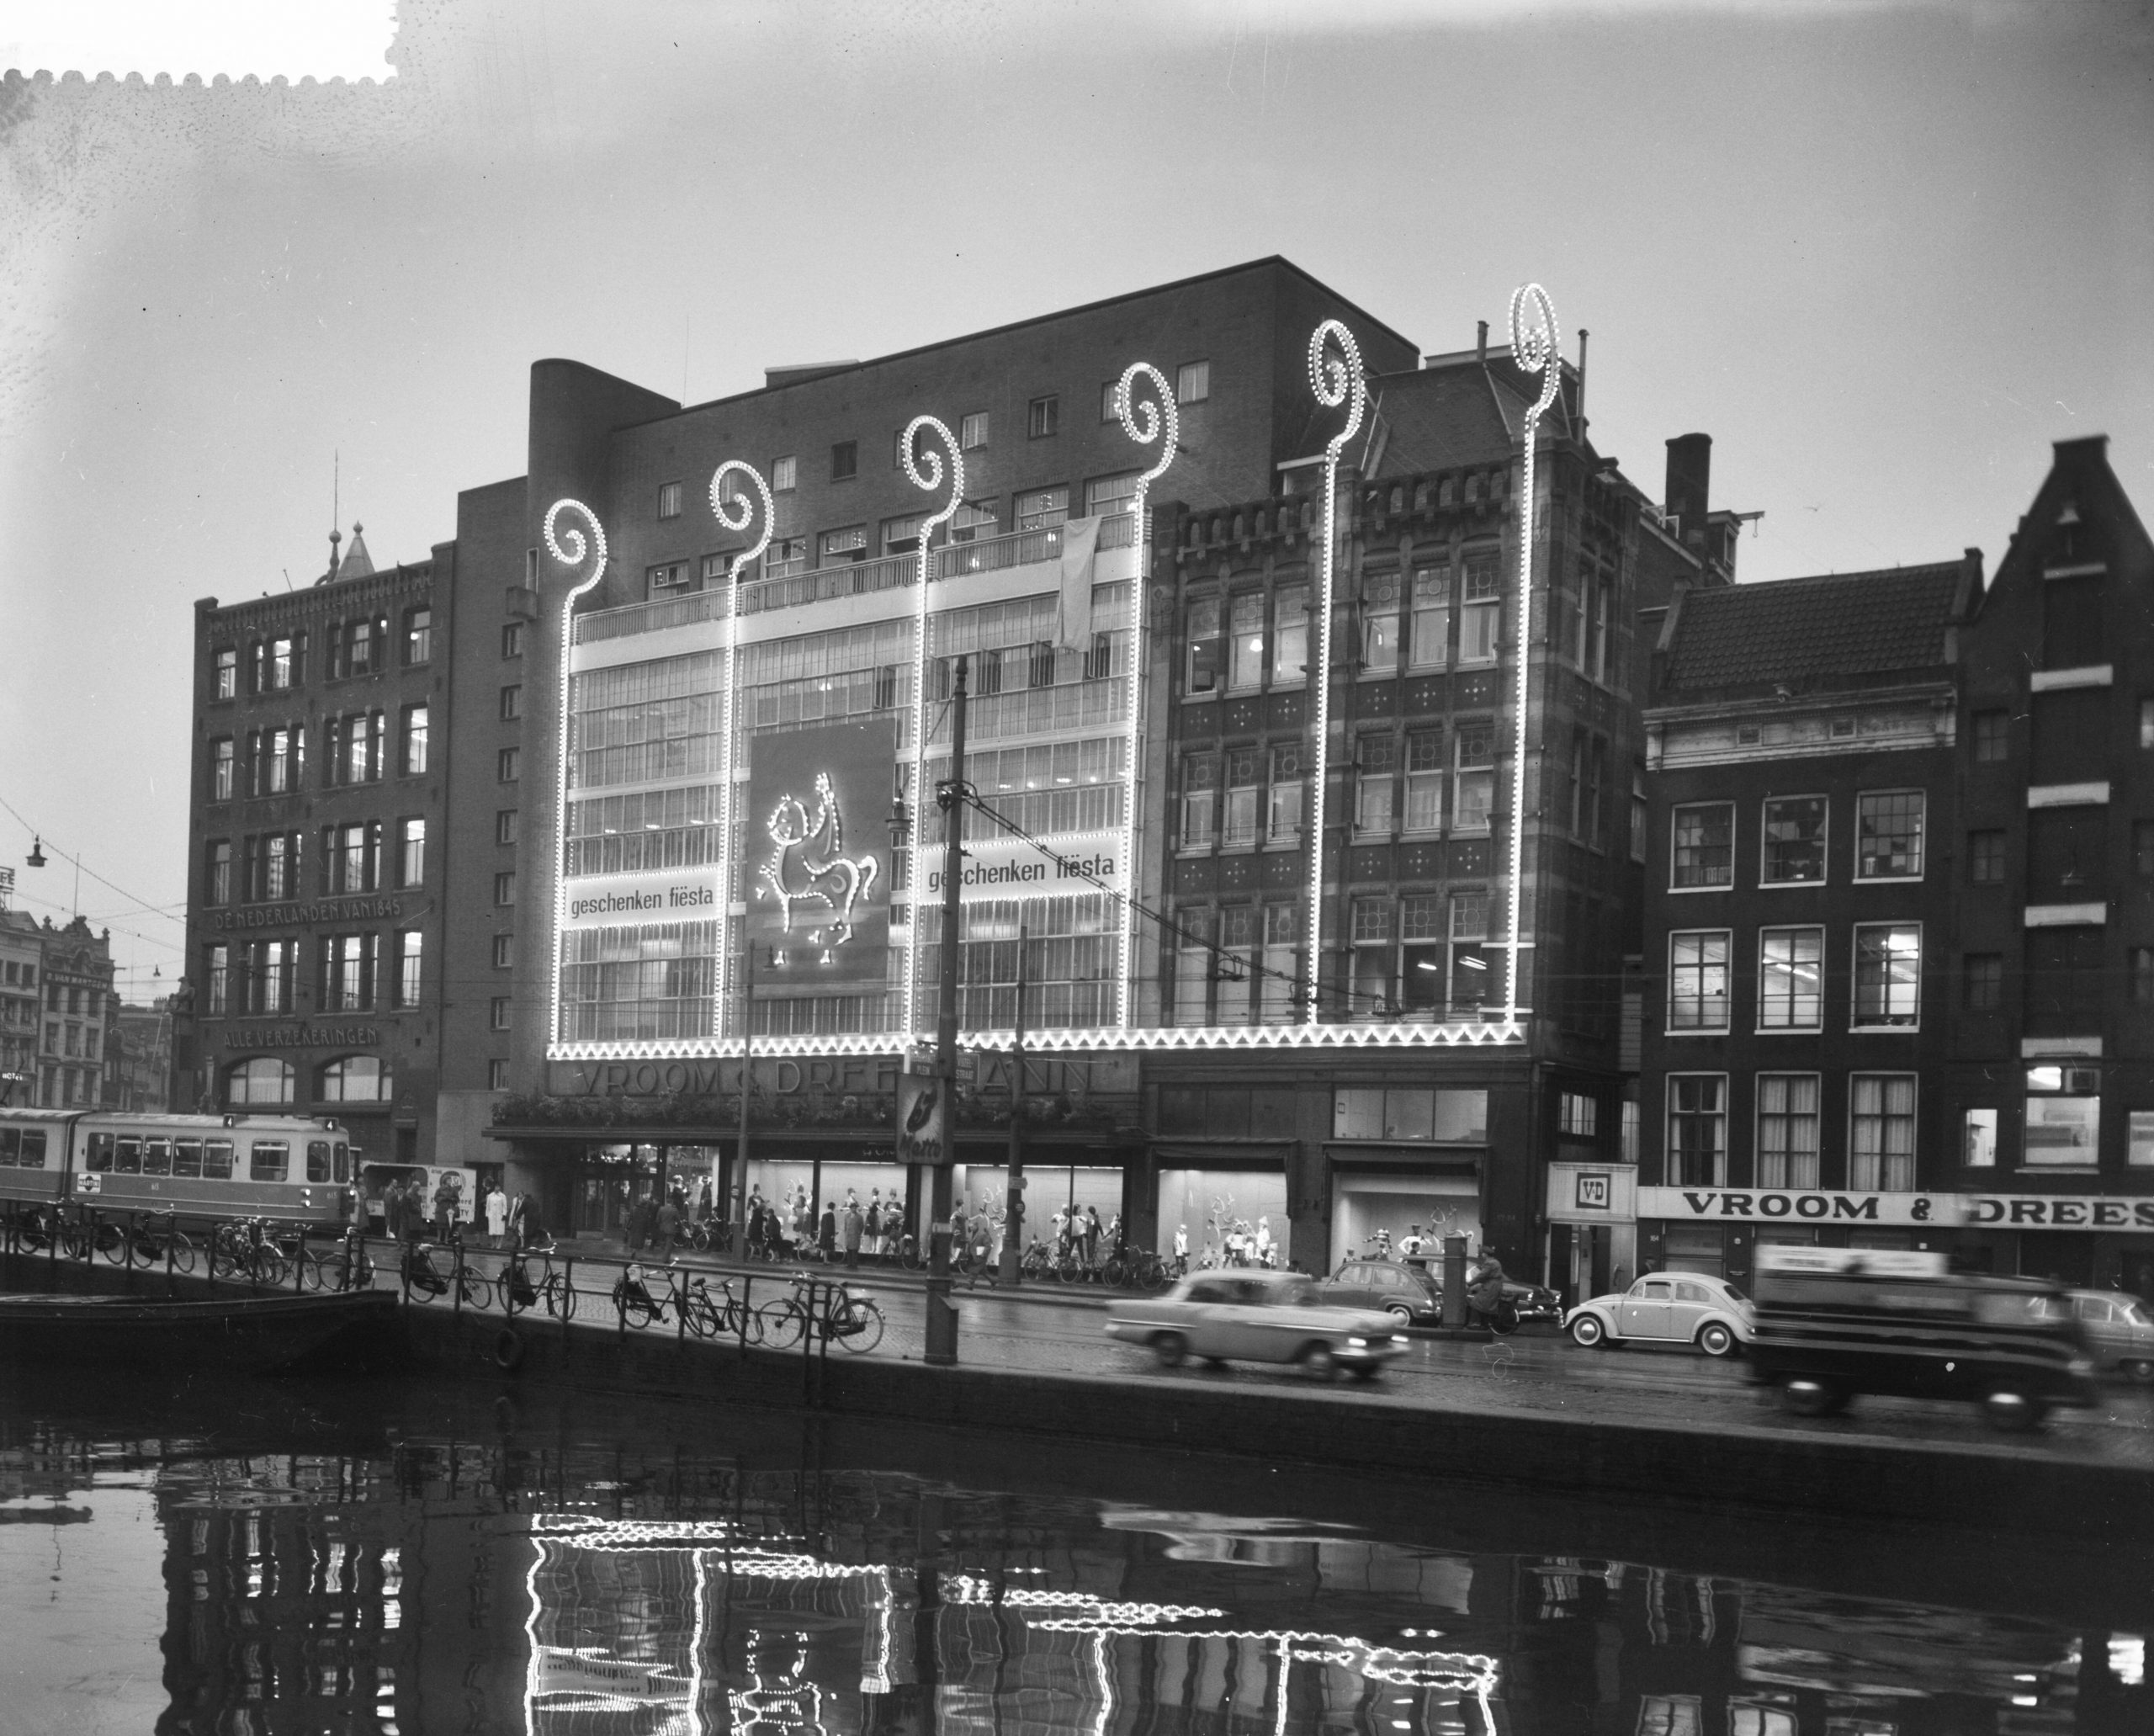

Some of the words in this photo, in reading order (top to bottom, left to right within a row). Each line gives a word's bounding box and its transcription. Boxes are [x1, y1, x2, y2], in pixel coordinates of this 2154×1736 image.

[215, 912, 231, 929] DE
[236, 903, 337, 928] NEDERLANDEN
[342, 901, 372, 919] VAN
[372, 899, 401, 917] 1845
[570, 889, 662, 919] geschenken
[669, 884, 714, 908] fiësta
[224, 1030, 252, 1048] ALLE
[257, 1027, 378, 1047] VERZEKERINGEN
[581, 1060, 721, 1094] VROOM
[226, 1117, 233, 1128] 4
[326, 1119, 334, 1130] 4
[78, 1179, 100, 1187] MARTINI
[1683, 1192, 1880, 1219] VROOM
[1910, 1197, 1933, 1221] &
